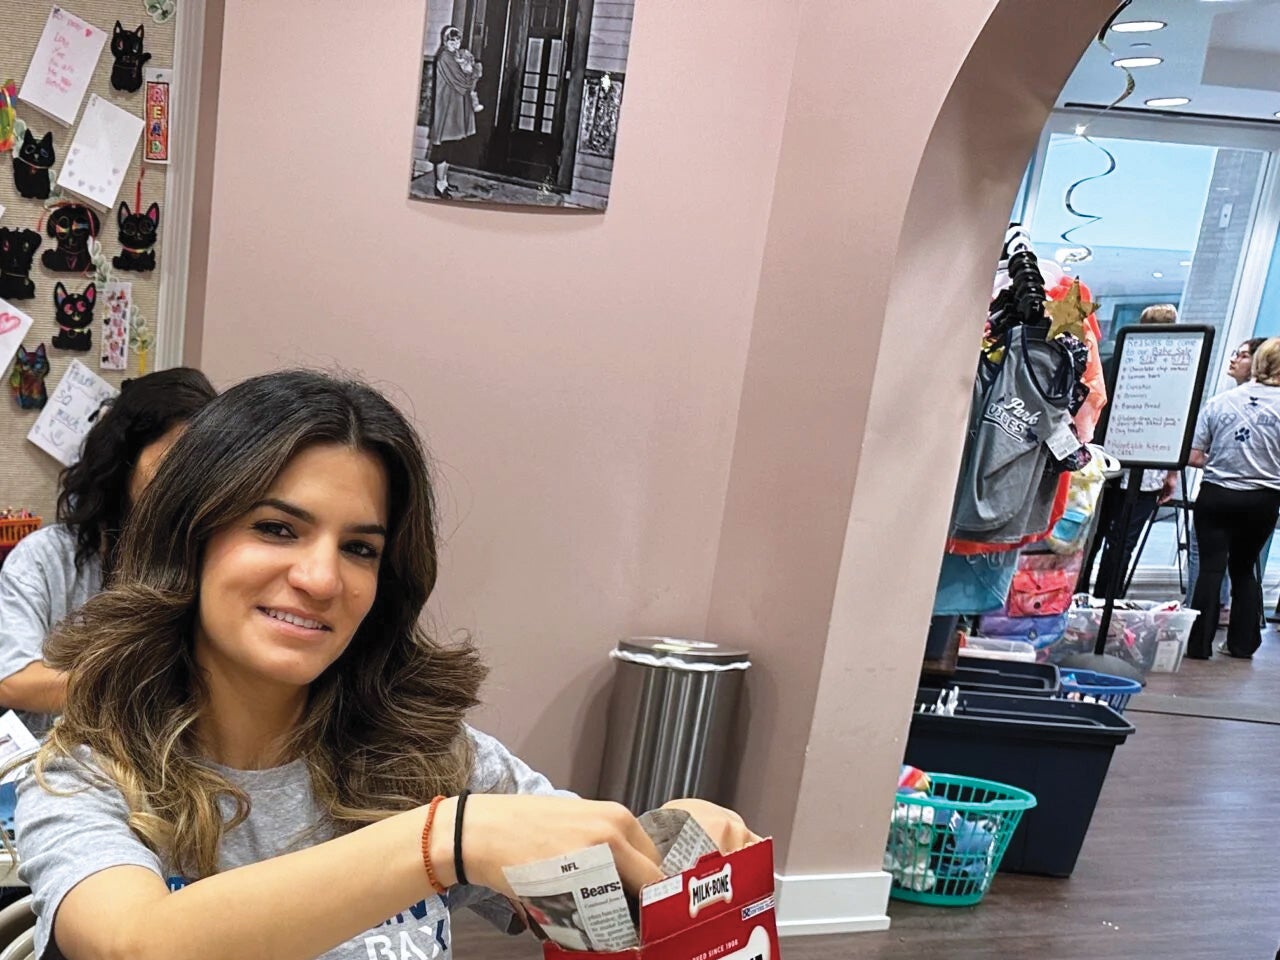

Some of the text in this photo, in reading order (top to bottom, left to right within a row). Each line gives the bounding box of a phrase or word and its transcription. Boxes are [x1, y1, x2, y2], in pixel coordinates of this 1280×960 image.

[149, 88, 162, 153] READ
[986, 402, 1027, 434] VIBES
[1004, 397, 1042, 425] Park
[561, 863, 580, 874] NFL
[580, 880, 622, 900] Bears:
[707, 945, 724, 958] SINCE
